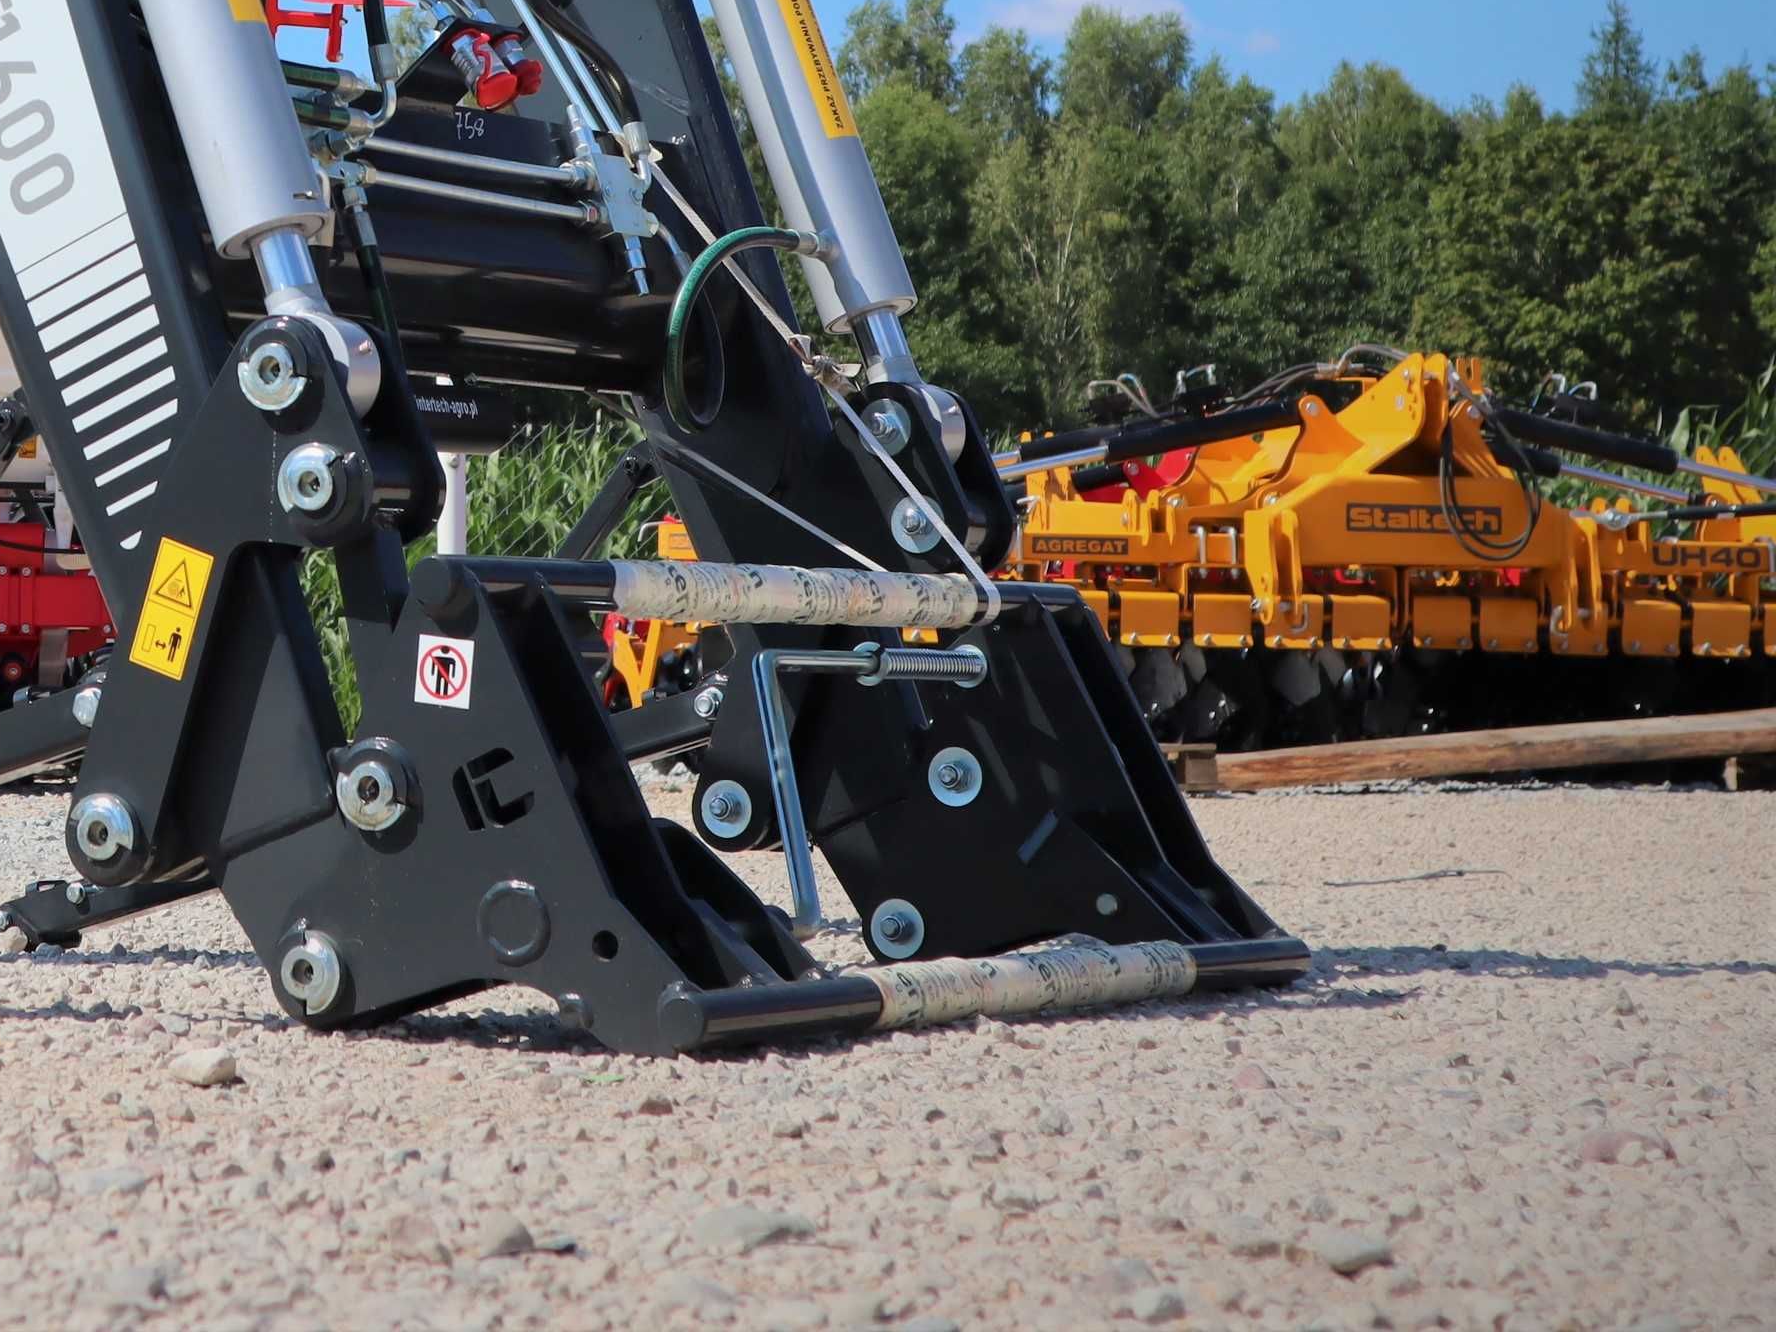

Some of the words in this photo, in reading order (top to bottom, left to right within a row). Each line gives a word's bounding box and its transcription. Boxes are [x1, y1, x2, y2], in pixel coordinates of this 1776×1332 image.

[799, 19, 830, 93] PRZEBYWANIA
[455, 112, 485, 141] 758
[827, 95, 845, 129] ZAKAZ
[1035, 539, 1126, 554] AGREGAT
[1652, 544, 1761, 568] UH40
